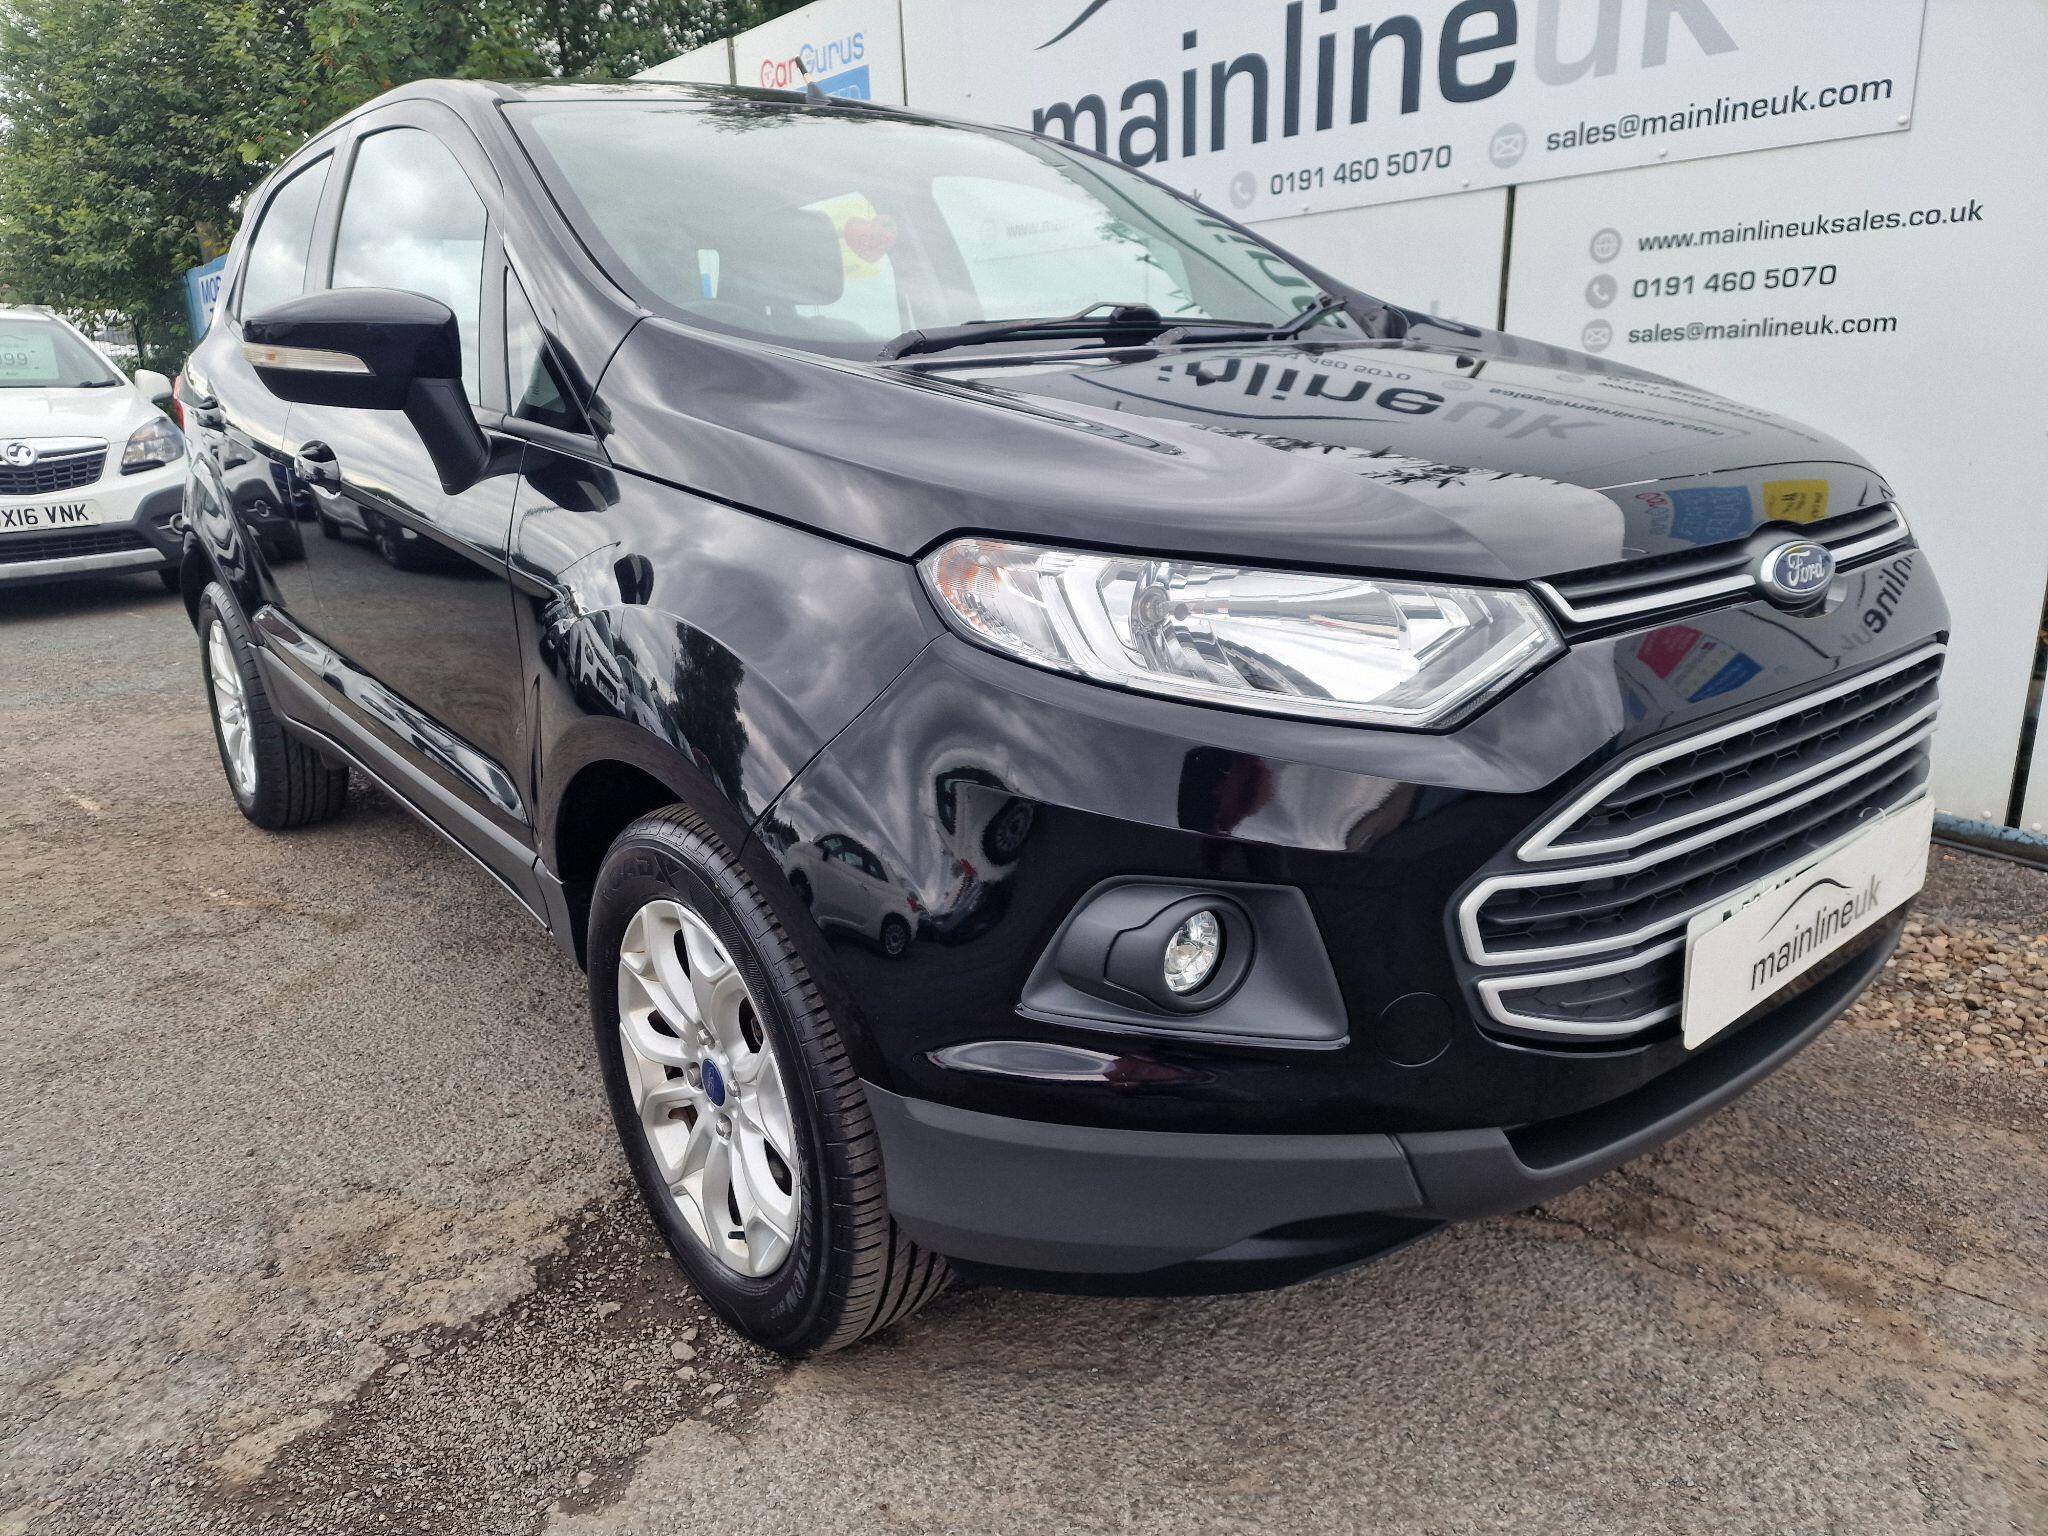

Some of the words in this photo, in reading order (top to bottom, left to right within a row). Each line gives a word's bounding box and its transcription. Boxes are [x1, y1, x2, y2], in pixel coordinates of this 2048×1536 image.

[760, 31, 865, 88] CarGurus
[1546, 78, 1893, 151] sales@mainlineuk.com
[1270, 167, 1325, 195] 0191
[1333, 157, 1379, 184] 460
[1387, 145, 1451, 176] 5070
[1637, 199, 1984, 252] www.mainlineuksales.co.uk
[1633, 274, 1695, 299] 0191
[1704, 270, 1756, 294] 460
[1763, 264, 1837, 289] 5070
[1628, 315, 1897, 344] sales@mainlineuk.com
[0, 509, 38, 528] X16
[44, 504, 89, 524] VNK
[1786, 551, 1827, 586] Ford
[1750, 874, 1882, 992] mainlineuk
